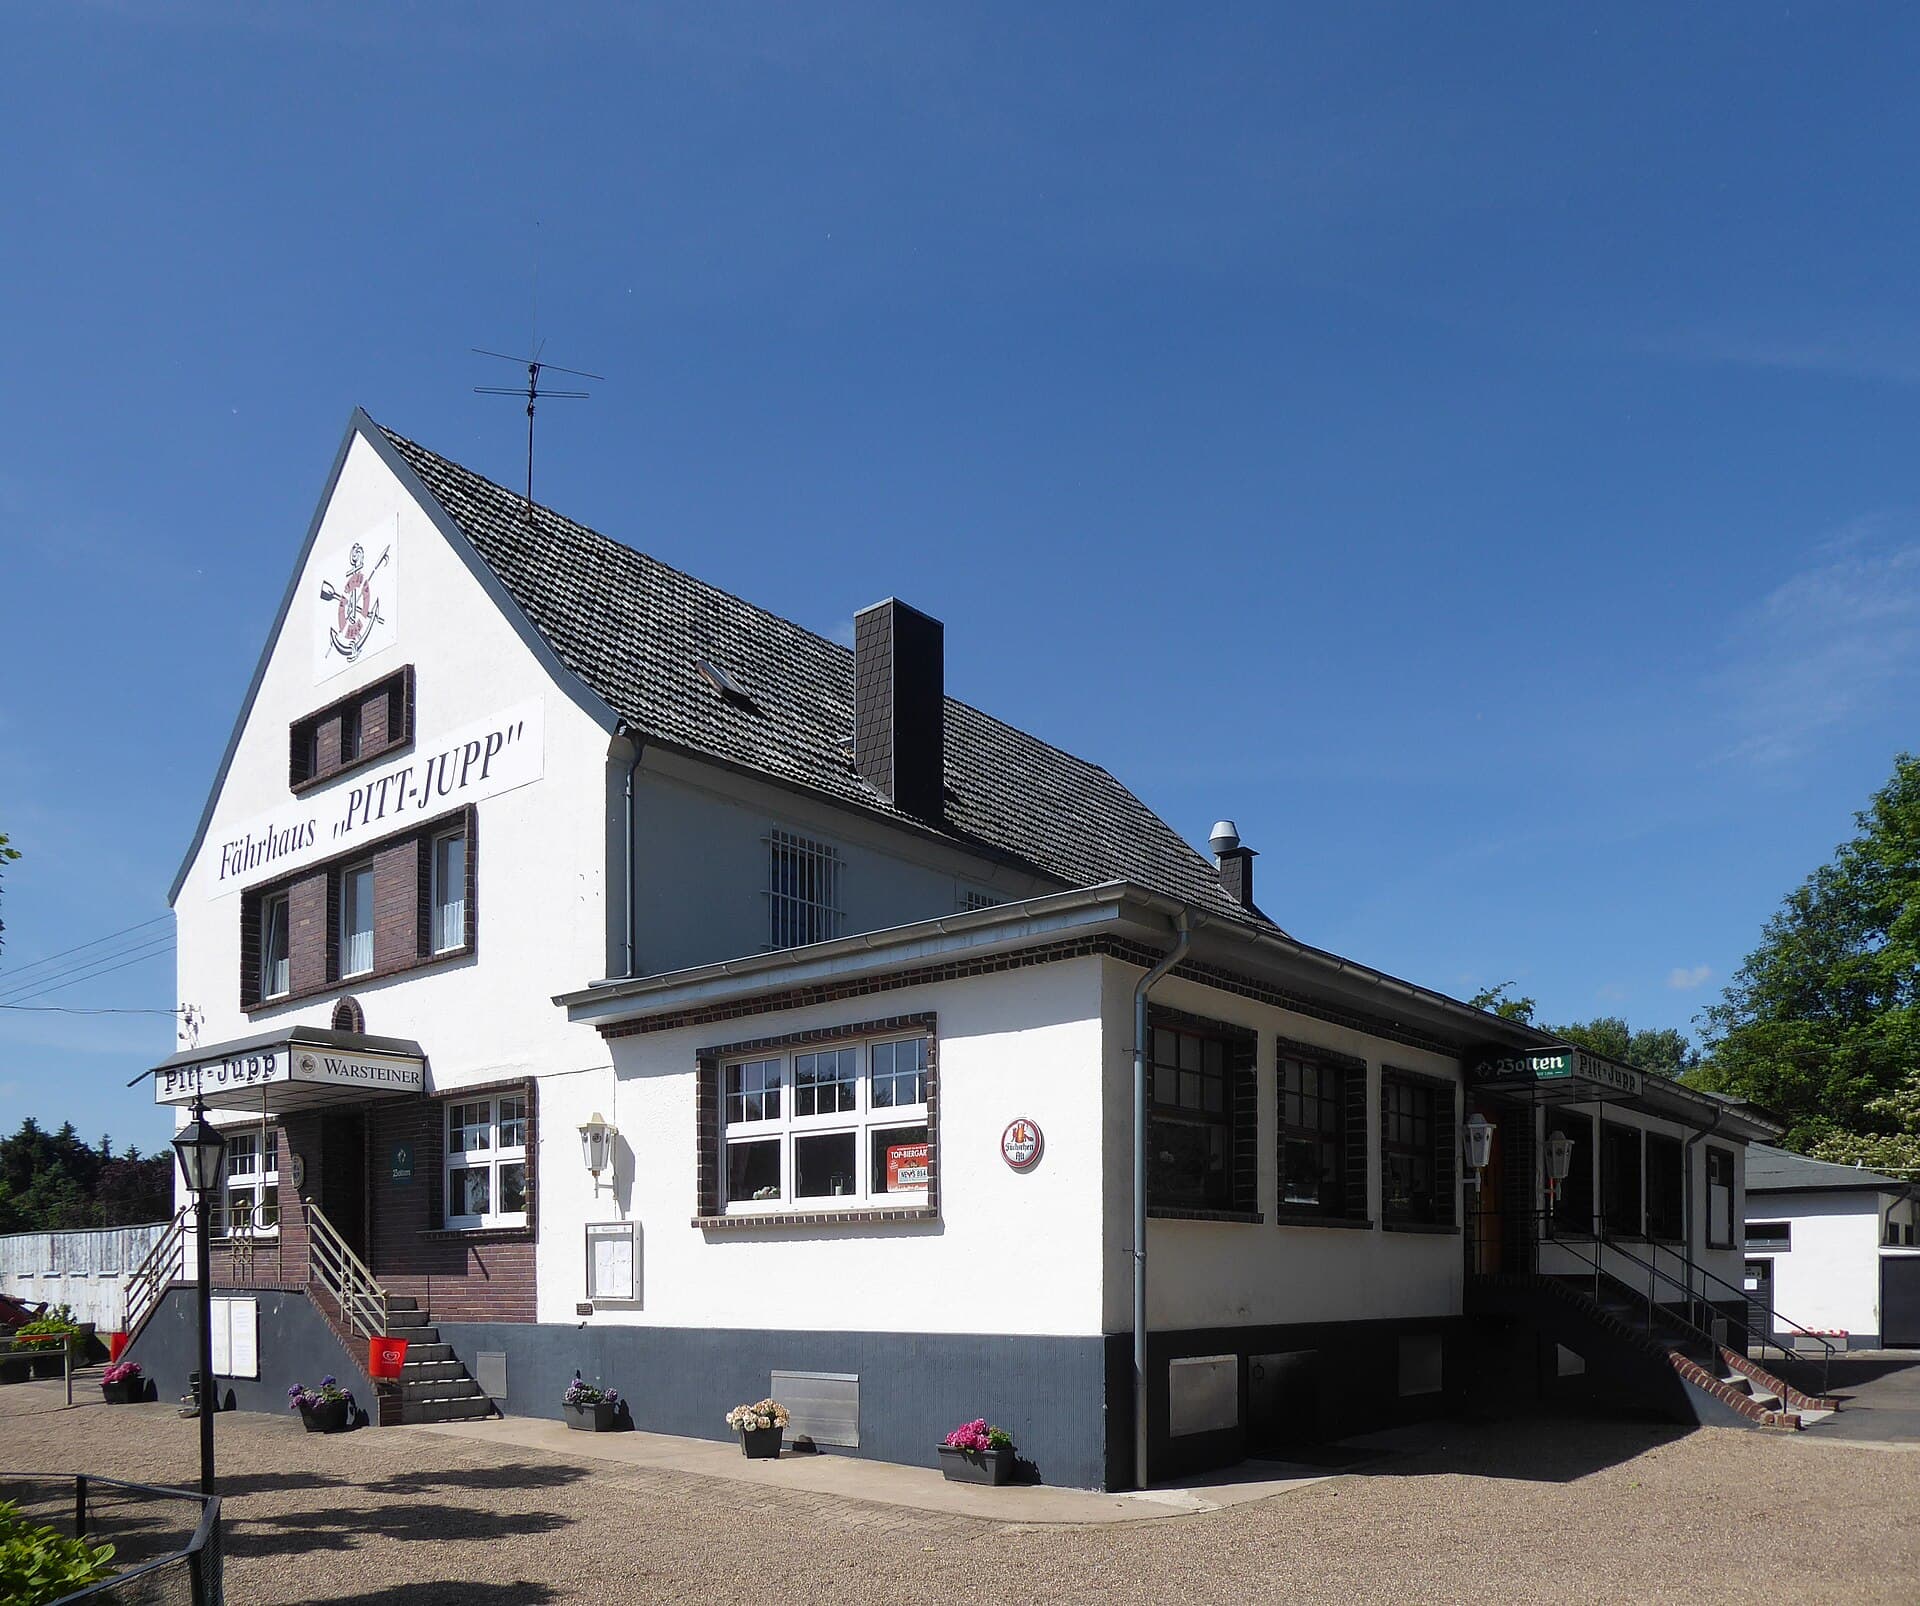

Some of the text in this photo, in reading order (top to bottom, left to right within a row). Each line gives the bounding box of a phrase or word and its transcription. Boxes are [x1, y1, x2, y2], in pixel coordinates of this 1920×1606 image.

[219, 818, 316, 880] Fährhaus
[164, 1054, 277, 1094] Pitt-Jupp
[323, 1058, 420, 1084] WARSTEINER
[891, 1149, 928, 1159] TOP-BIERGAR
